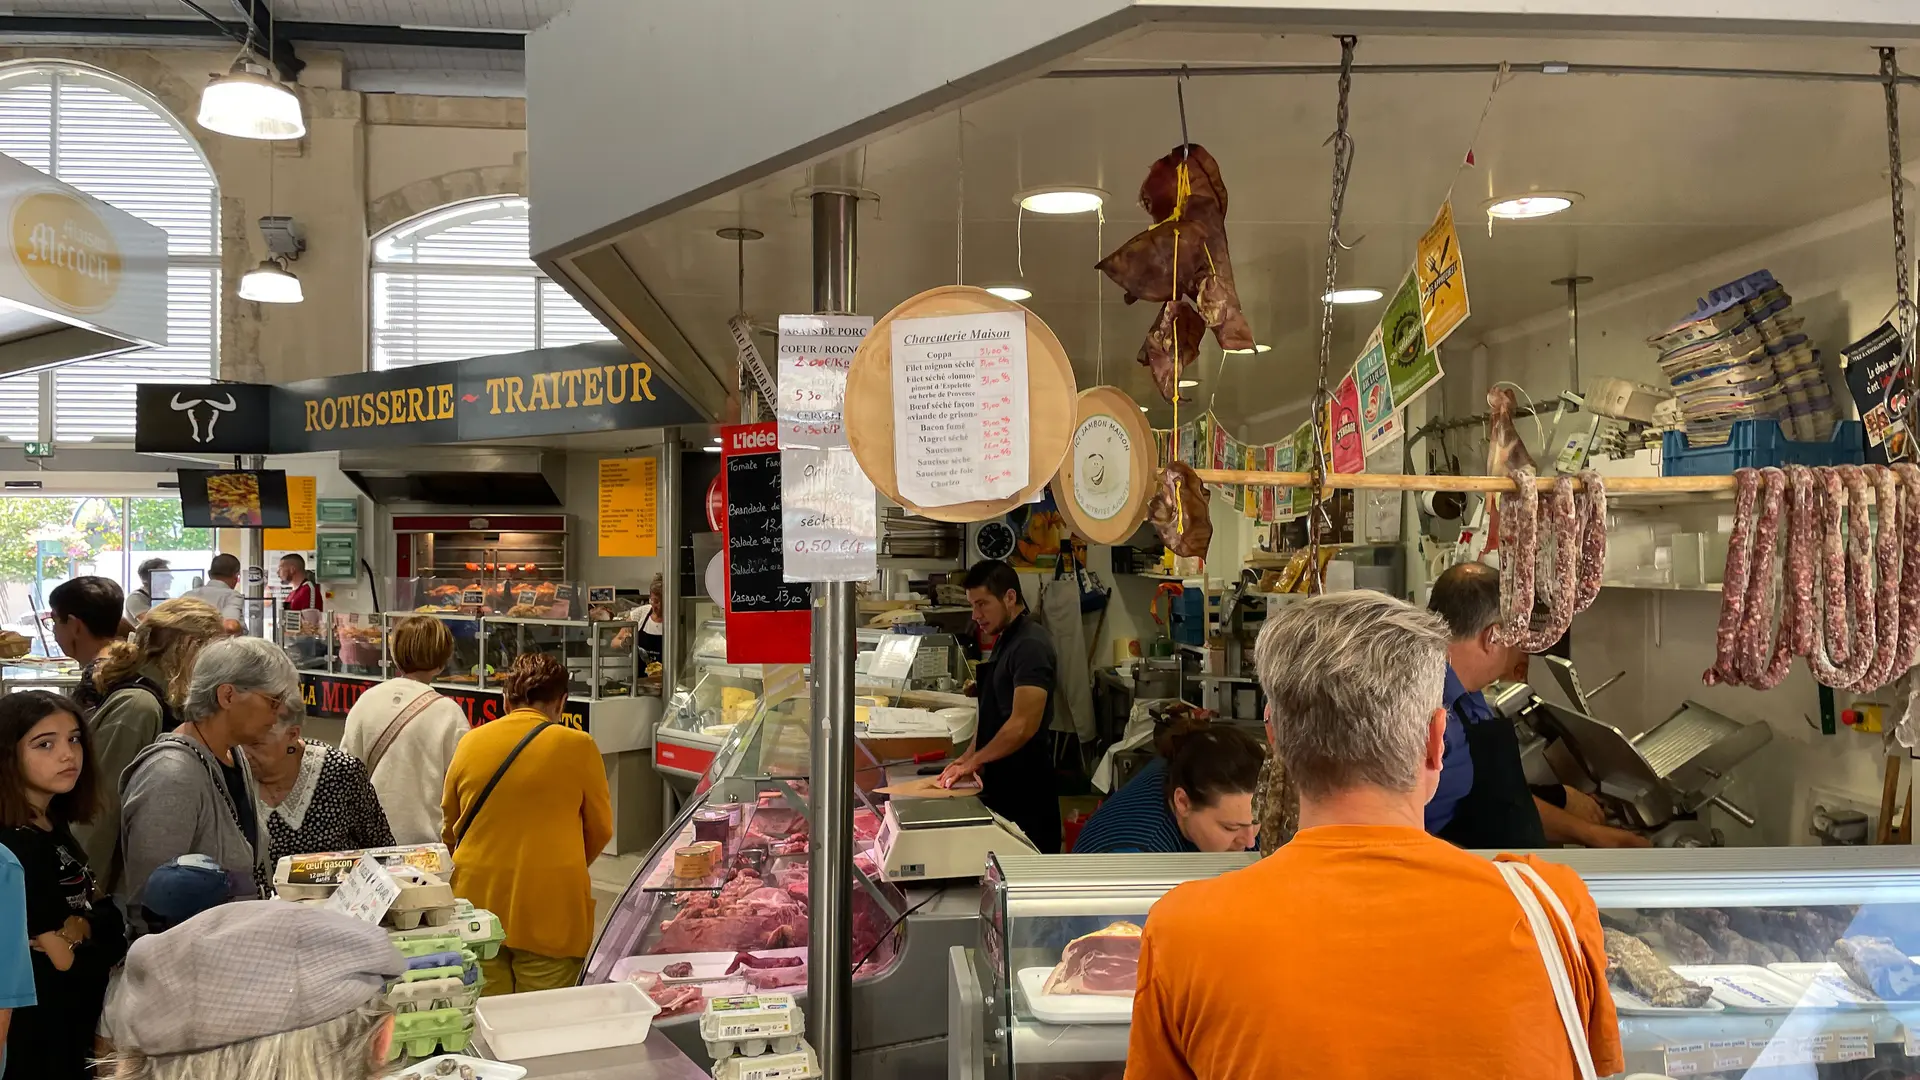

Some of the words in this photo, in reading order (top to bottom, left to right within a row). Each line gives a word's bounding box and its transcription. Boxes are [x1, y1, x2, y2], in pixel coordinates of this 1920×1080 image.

[821, 328, 835, 337] DE
[838, 328, 868, 337] PORC
[904, 331, 967, 345] Charcuterie
[970, 329, 1010, 339] Maison
[781, 345, 817, 354] COEUR
[927, 351, 952, 360] Coppa
[905, 364, 922, 372] Filet
[924, 362, 953, 371] mignon
[906, 375, 923, 383] Filet
[911, 384, 933, 393] piment
[304, 384, 455, 432] ROTISSERIE
[486, 362, 657, 415] TRAITEUR
[953, 401, 975, 409] façon
[946, 423, 966, 431] fumé
[733, 430, 777, 449] L'idée
[918, 435, 946, 443] Magret
[1082, 420, 1107, 436] JAMBON
[1109, 423, 1130, 451] MAISON
[727, 459, 758, 472] Tomate
[917, 458, 949, 466] Saucisse
[916, 470, 948, 478] Saucisse
[730, 535, 759, 548] Salade
[795, 540, 831, 553] 0,50
[730, 564, 757, 575] Salade
[731, 591, 770, 606] Lasagne
[324, 859, 353, 872] gascon
